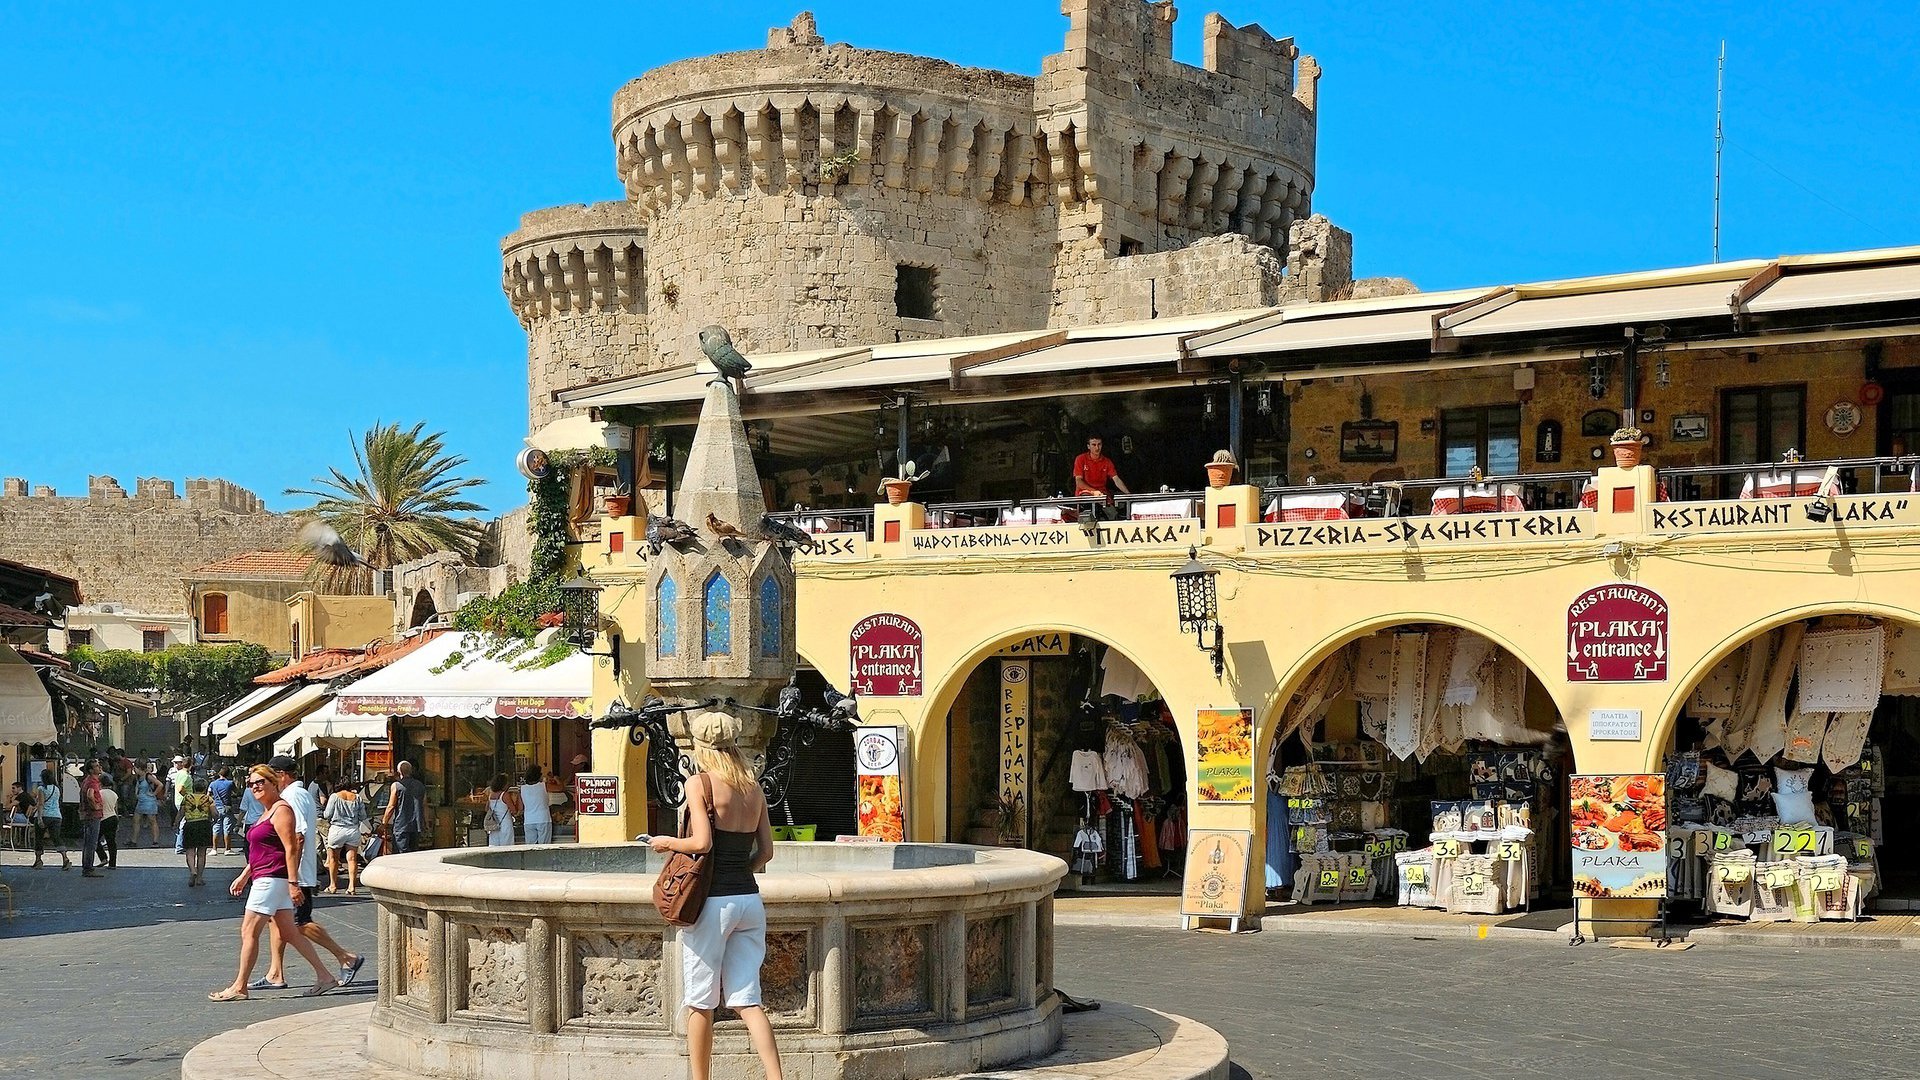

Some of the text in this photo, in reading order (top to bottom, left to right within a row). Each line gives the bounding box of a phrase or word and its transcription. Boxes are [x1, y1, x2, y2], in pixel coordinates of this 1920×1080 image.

[1653, 500, 1908, 529] RESTAURANT "LAKA"
[1257, 515, 1582, 546] PIZZERIA-SPAGHETTERIA
[797, 537, 855, 556] OUSE
[1570, 587, 1666, 617] RESTAURANT
[851, 616, 921, 641] RESTAURANT
[1571, 620, 1664, 637] "PLAKA"
[852, 644, 919, 659] "PLAKA"
[1583, 640, 1652, 657] entrance
[861, 661, 911, 676] entrance
[358, 704, 387, 712] Smoothies
[515, 706, 538, 714] Coffees
[517, 698, 528, 706] Hot
[529, 698, 545, 707] Dogs
[1206, 767, 1241, 777] PLAKA
[1672, 837, 1684, 859] 3
[1698, 832, 1710, 855] 3
[1717, 833, 1728, 850] 3
[1581, 856, 1640, 867] PLAKA
